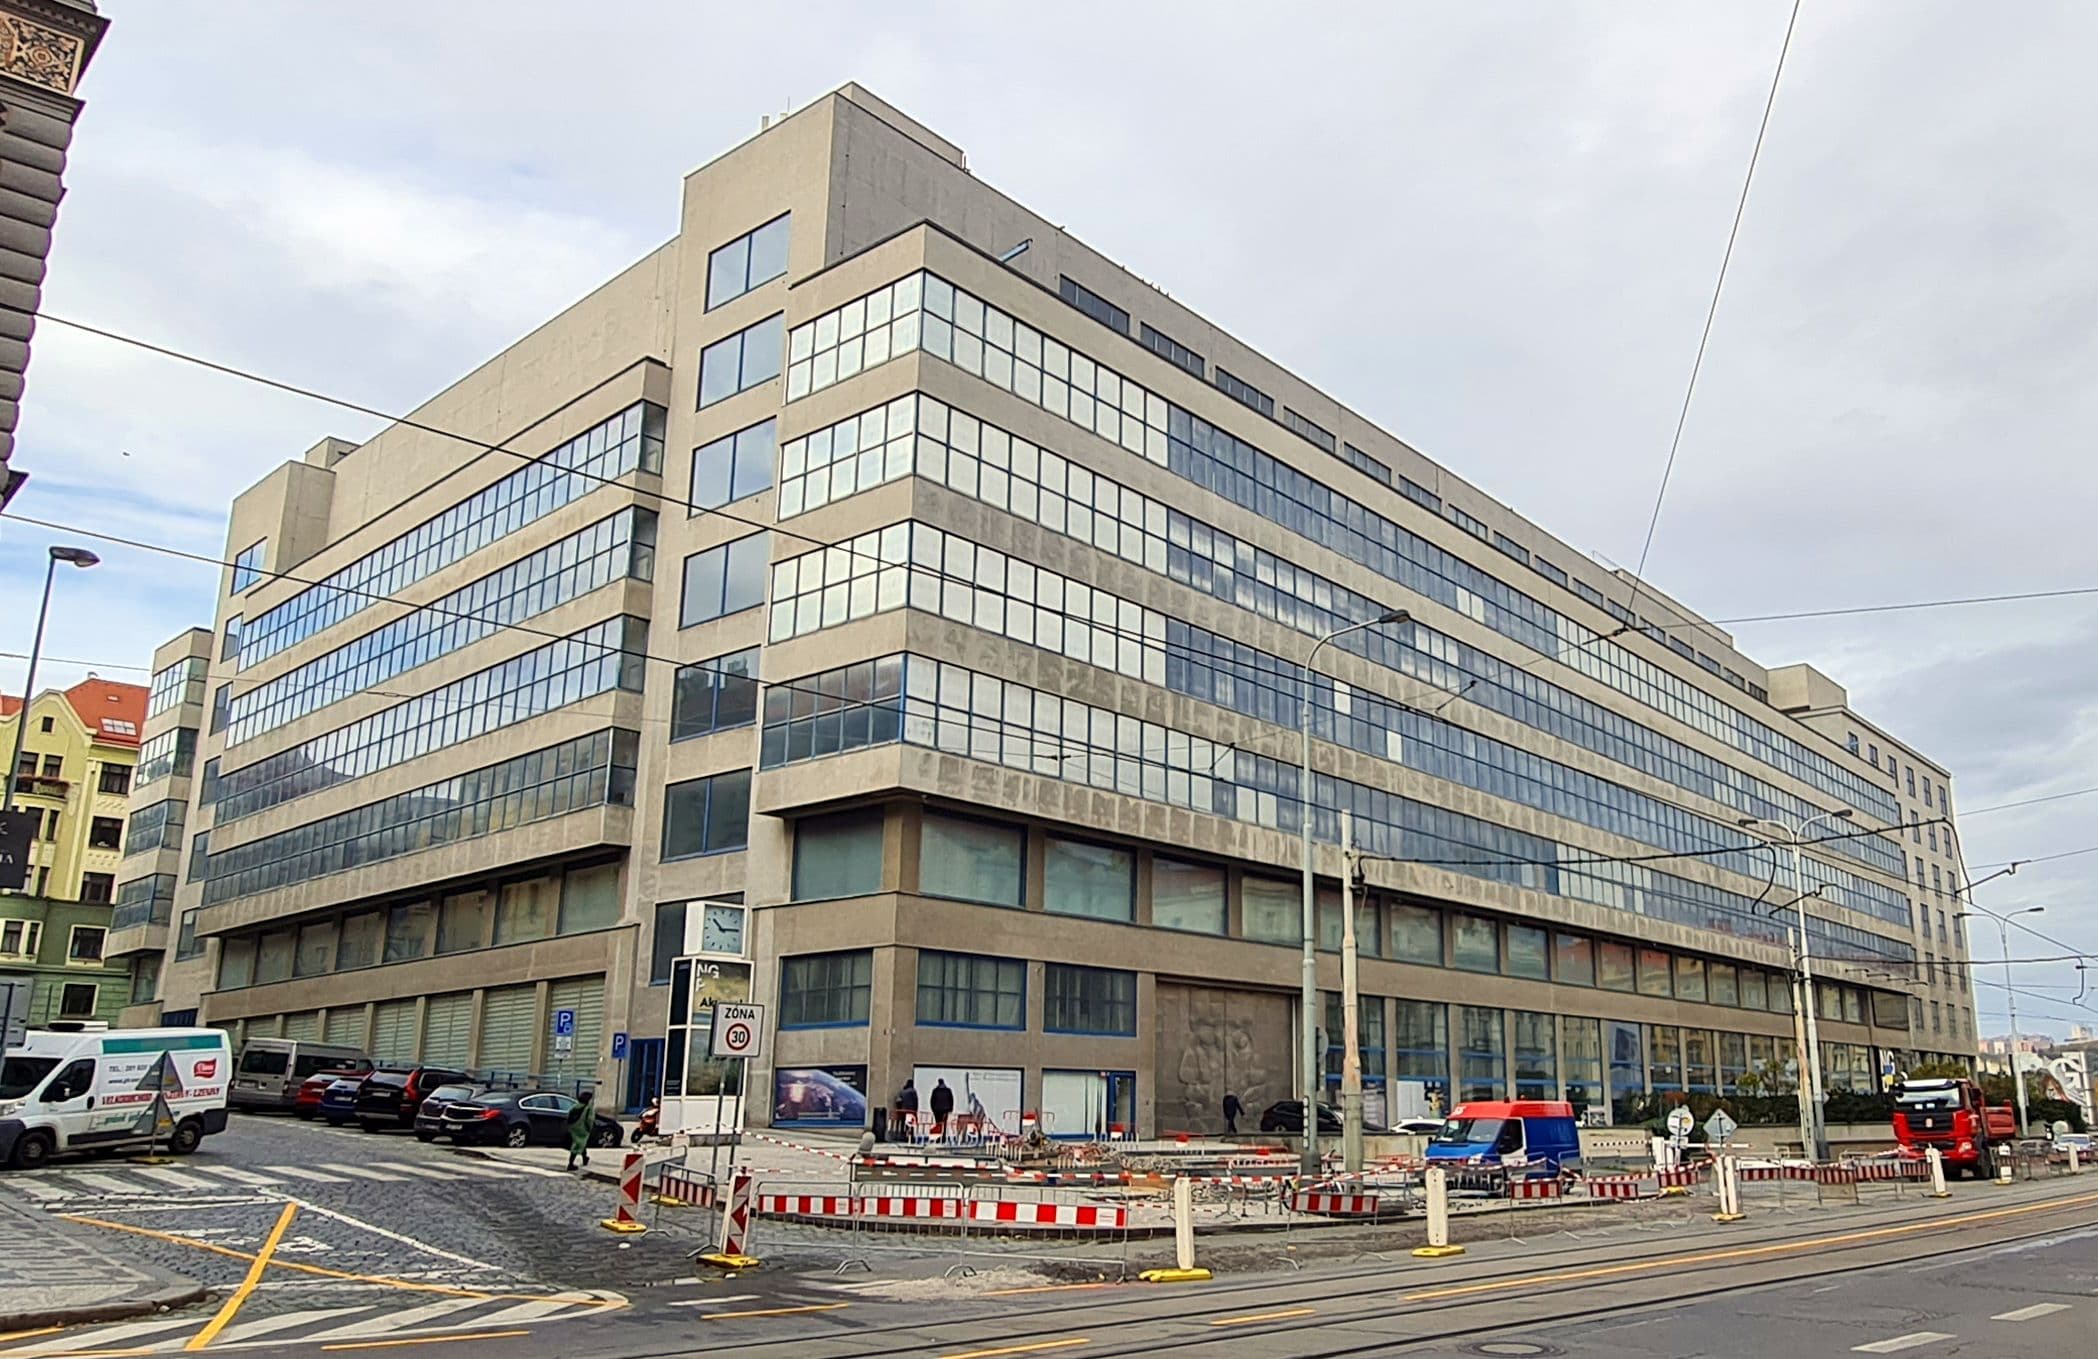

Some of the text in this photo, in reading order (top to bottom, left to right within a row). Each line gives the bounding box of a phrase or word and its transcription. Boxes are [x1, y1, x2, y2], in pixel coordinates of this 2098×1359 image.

[696, 963, 720, 979] NG
[560, 1012, 571, 1028] P
[724, 1007, 756, 1020] ZONA
[614, 1035, 625, 1051] P
[731, 1030, 746, 1044] 30
